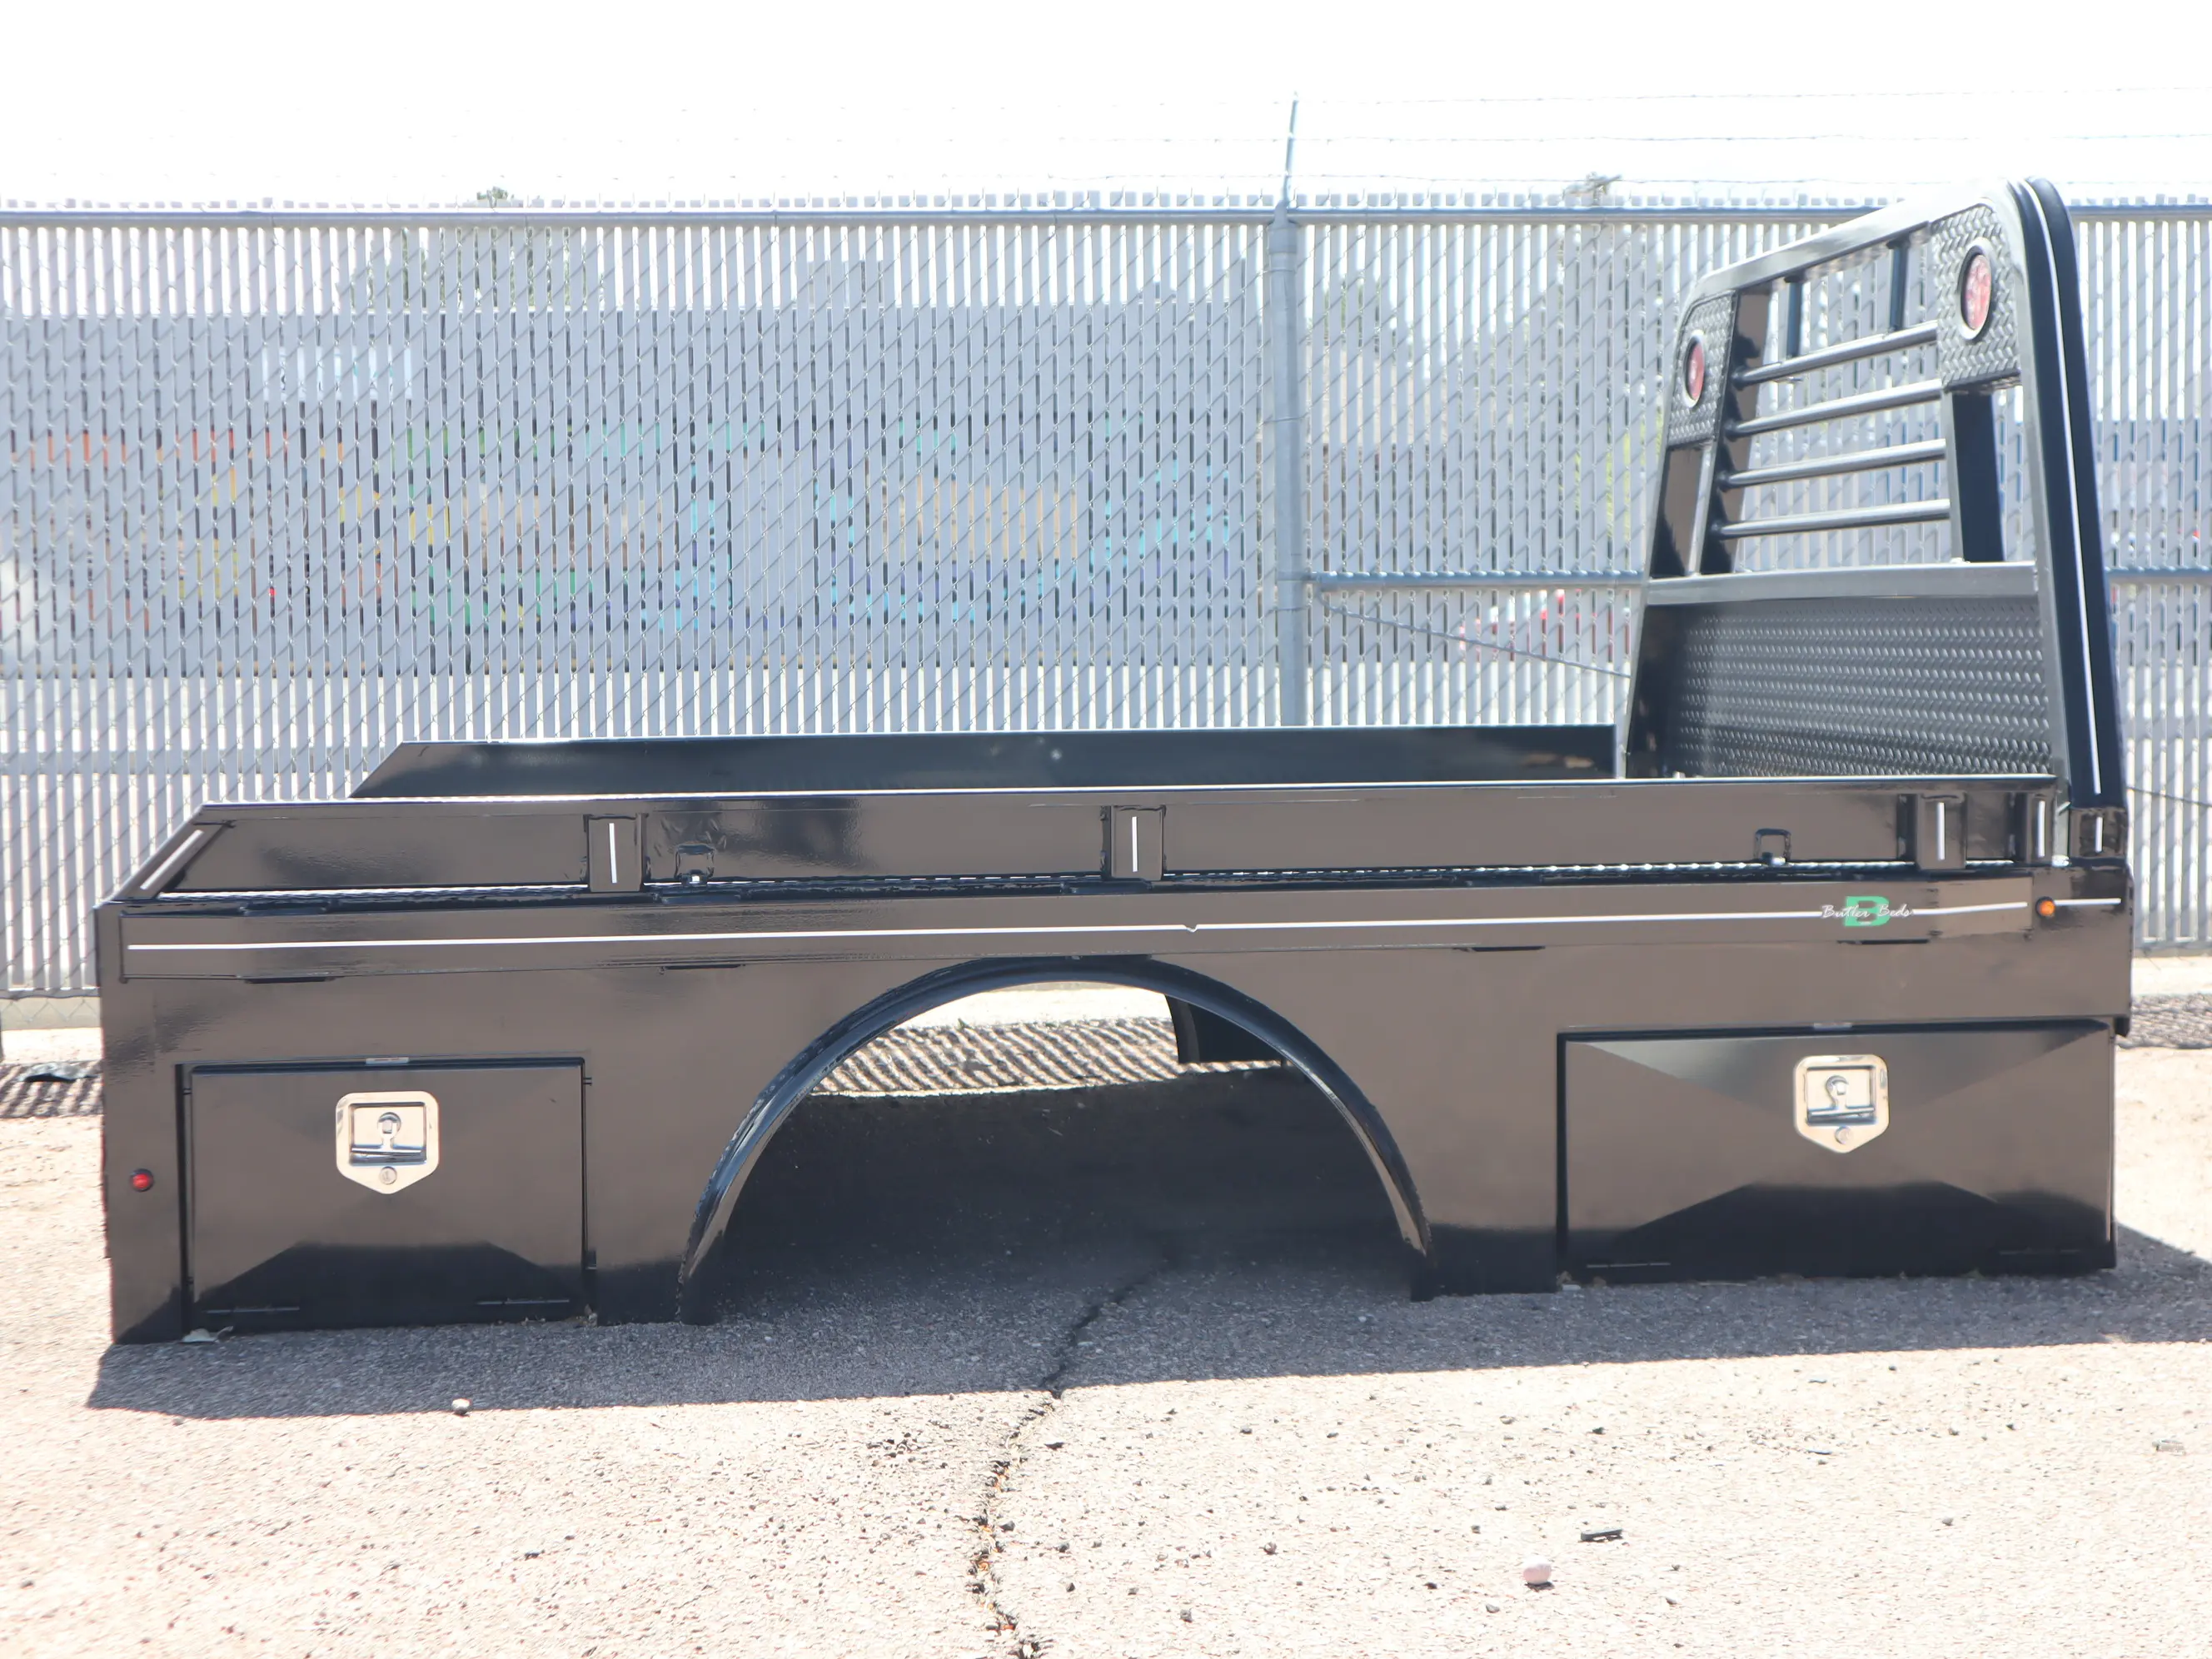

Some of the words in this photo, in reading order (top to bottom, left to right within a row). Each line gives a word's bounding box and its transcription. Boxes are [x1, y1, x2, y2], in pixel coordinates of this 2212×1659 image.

[1822, 904, 1871, 919] Butler
[1877, 904, 1913, 917] Beds
[1844, 895, 1891, 926] B
